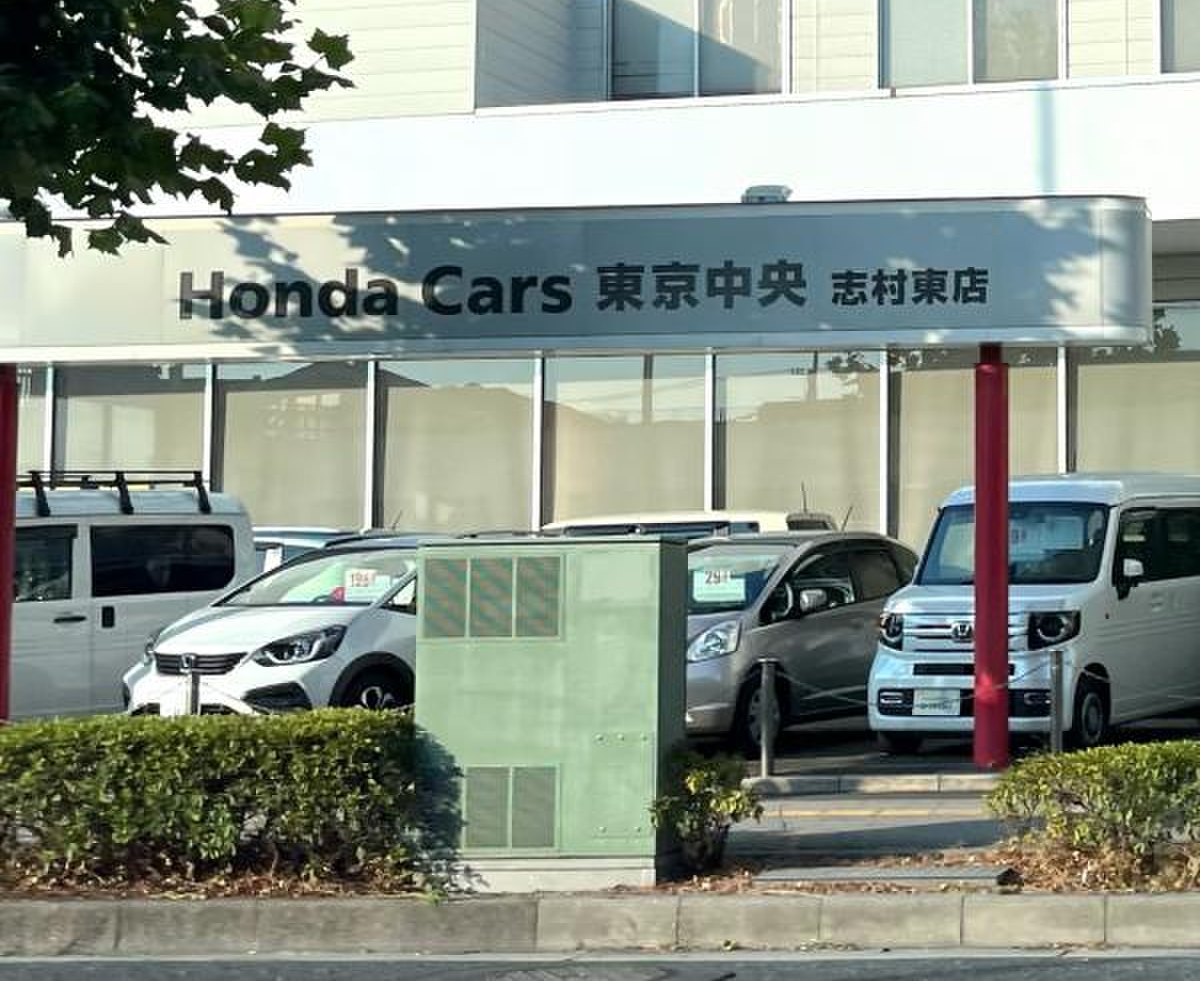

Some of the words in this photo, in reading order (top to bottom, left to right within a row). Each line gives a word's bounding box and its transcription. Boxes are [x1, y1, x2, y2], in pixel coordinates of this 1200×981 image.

[180, 268, 398, 320] Honda
[422, 265, 572, 317] Cars
[597, 260, 807, 311] 東京中央
[831, 267, 989, 306] 志村東店
